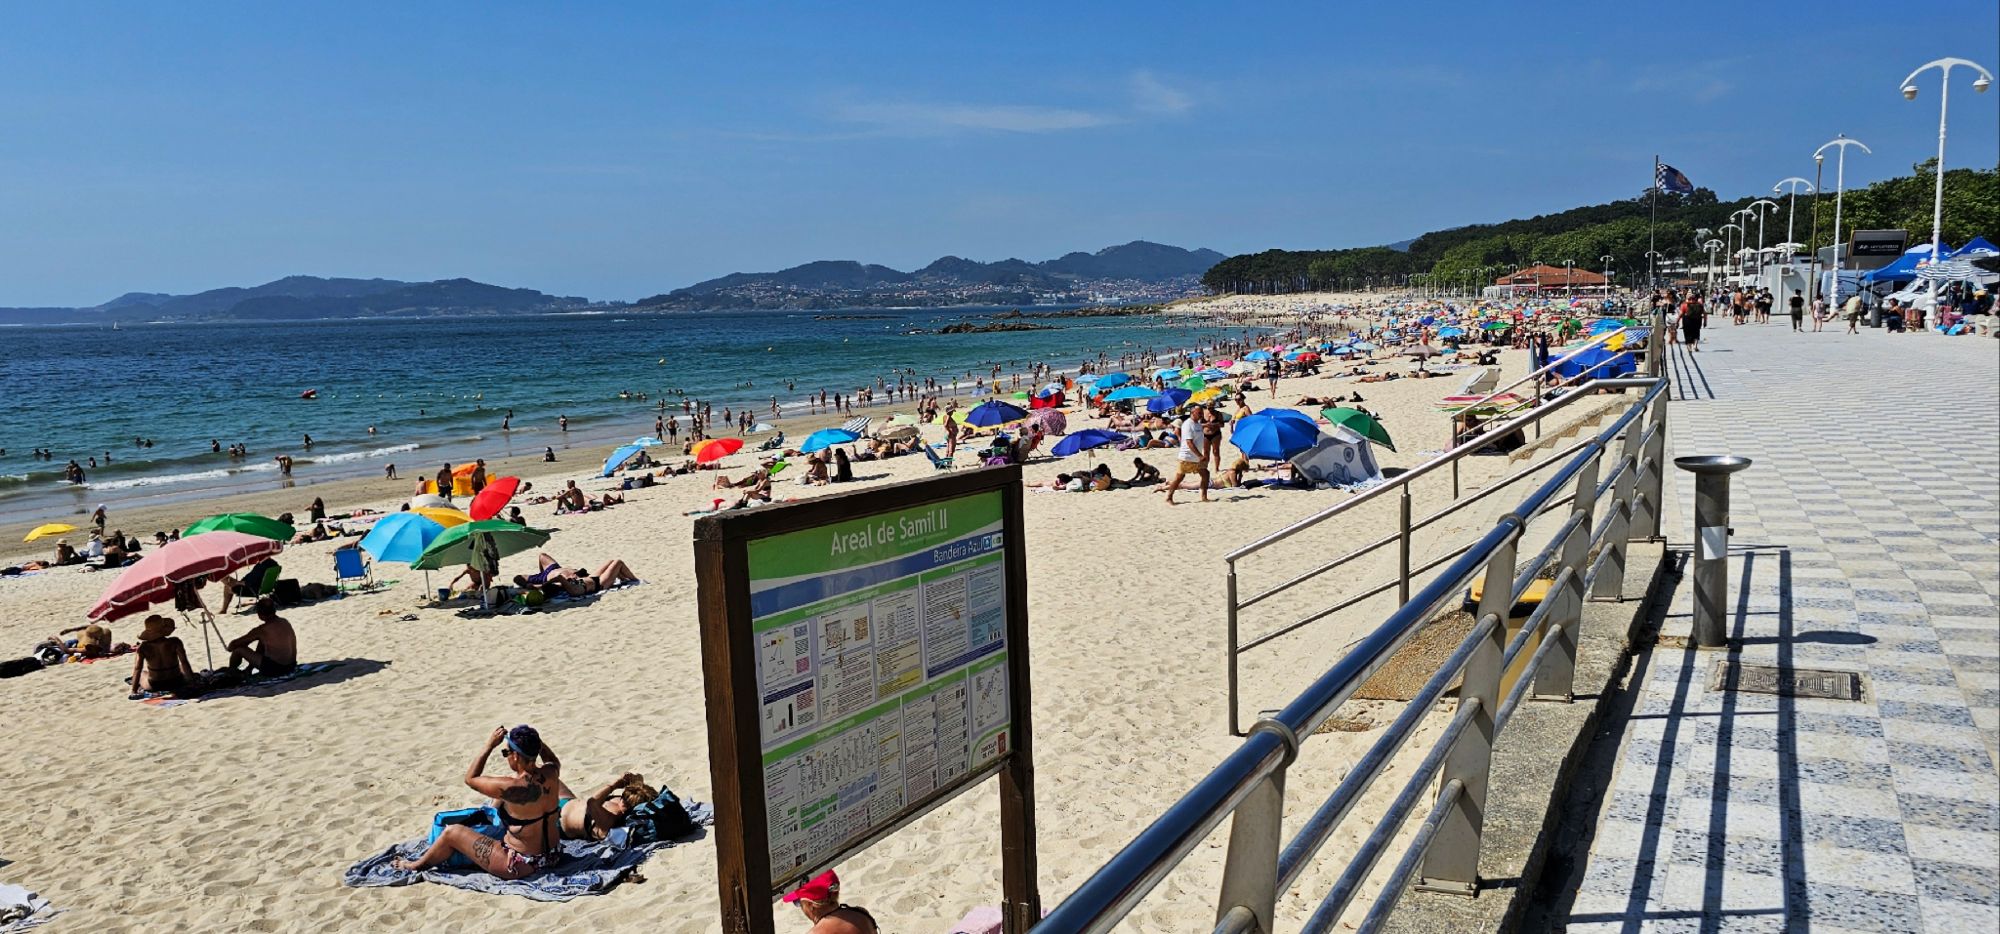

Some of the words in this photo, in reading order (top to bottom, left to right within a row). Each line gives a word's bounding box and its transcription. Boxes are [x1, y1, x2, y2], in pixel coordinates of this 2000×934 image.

[831, 523, 873, 556] Areal
[877, 521, 895, 545] de
[899, 510, 936, 540] Samil
[939, 508, 948, 530] II
[933, 543, 967, 564] Bandeira
[968, 537, 983, 554] Azul
